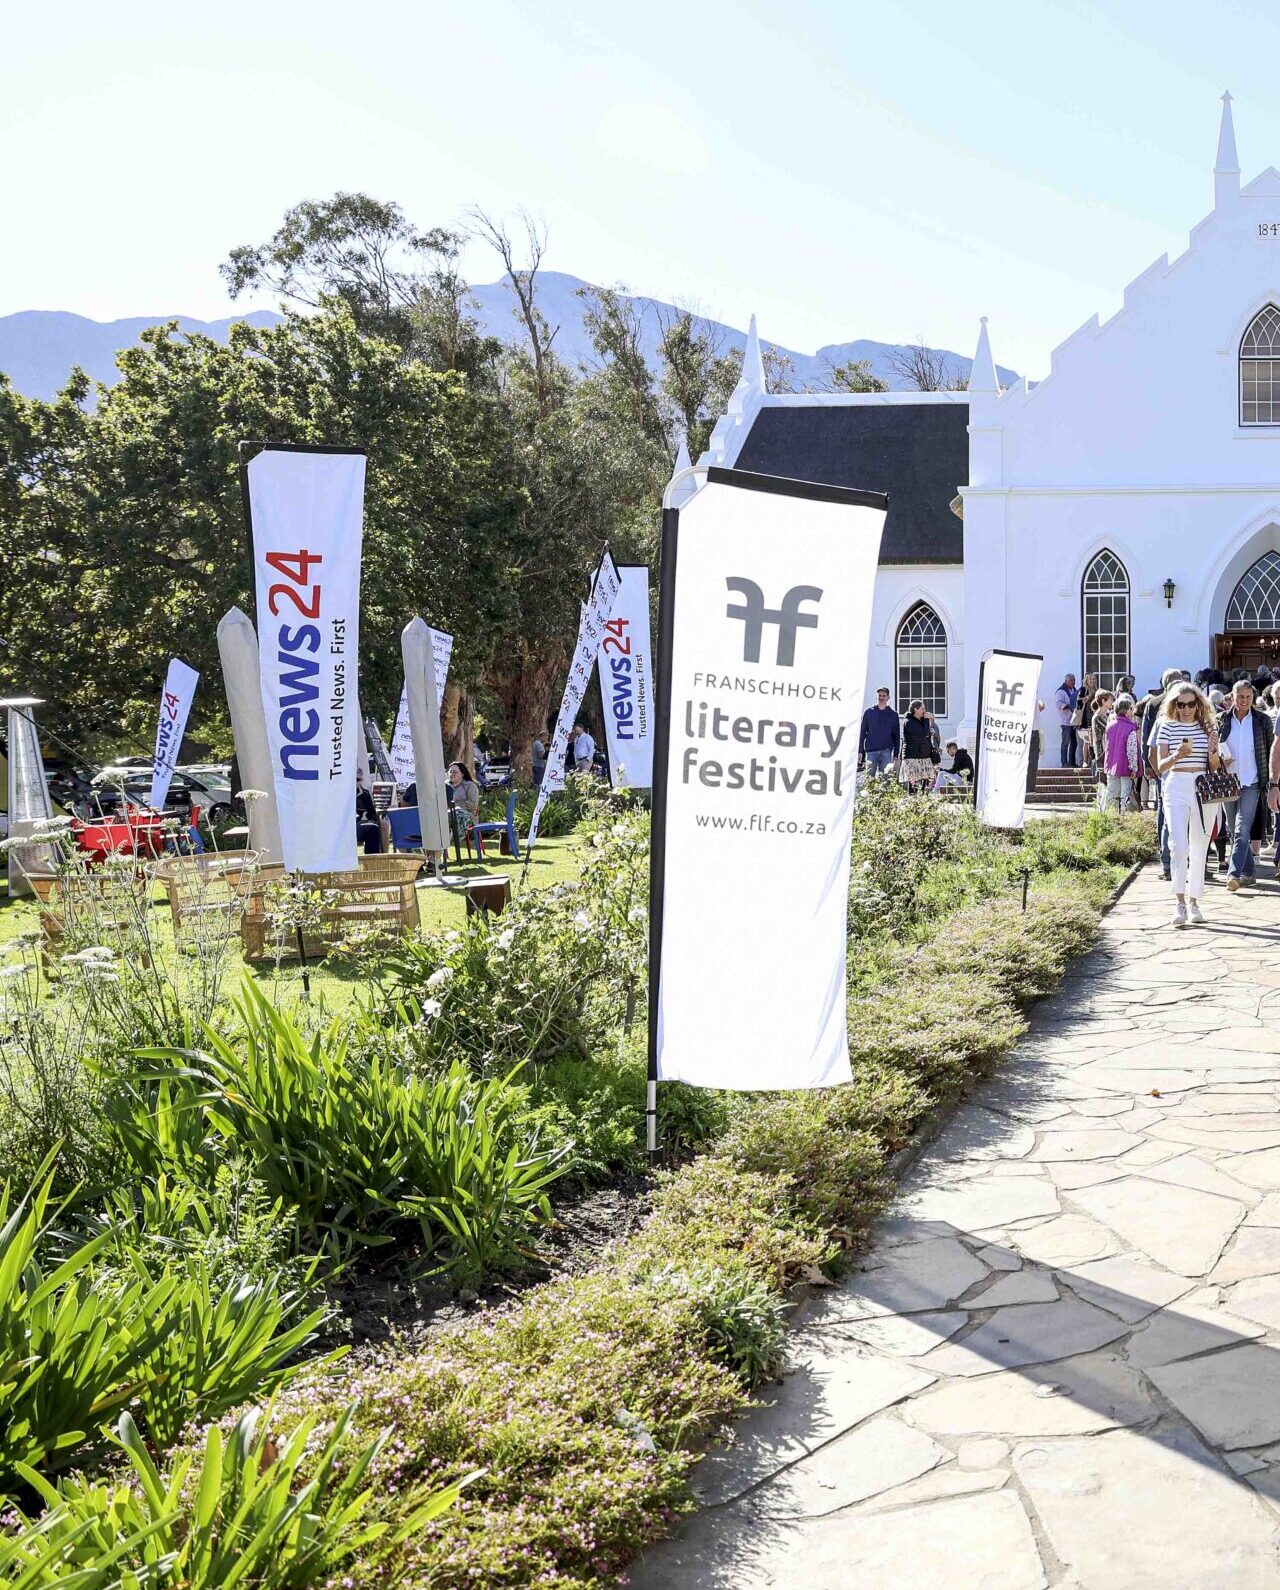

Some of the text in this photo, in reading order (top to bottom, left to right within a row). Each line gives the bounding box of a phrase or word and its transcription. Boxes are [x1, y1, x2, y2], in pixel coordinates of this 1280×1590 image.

[265, 549, 322, 780] news24
[603, 617, 634, 740] news24
[330, 619, 346, 780] Trusted News. First
[694, 672, 842, 701] FRANSCHHOEK
[638, 705, 647, 739] Trusted
[685, 700, 846, 758] literary
[983, 728, 1027, 744] festival
[984, 714, 1028, 733] literary
[682, 747, 843, 796] festival
[695, 814, 826, 835] www.flf.co.za
